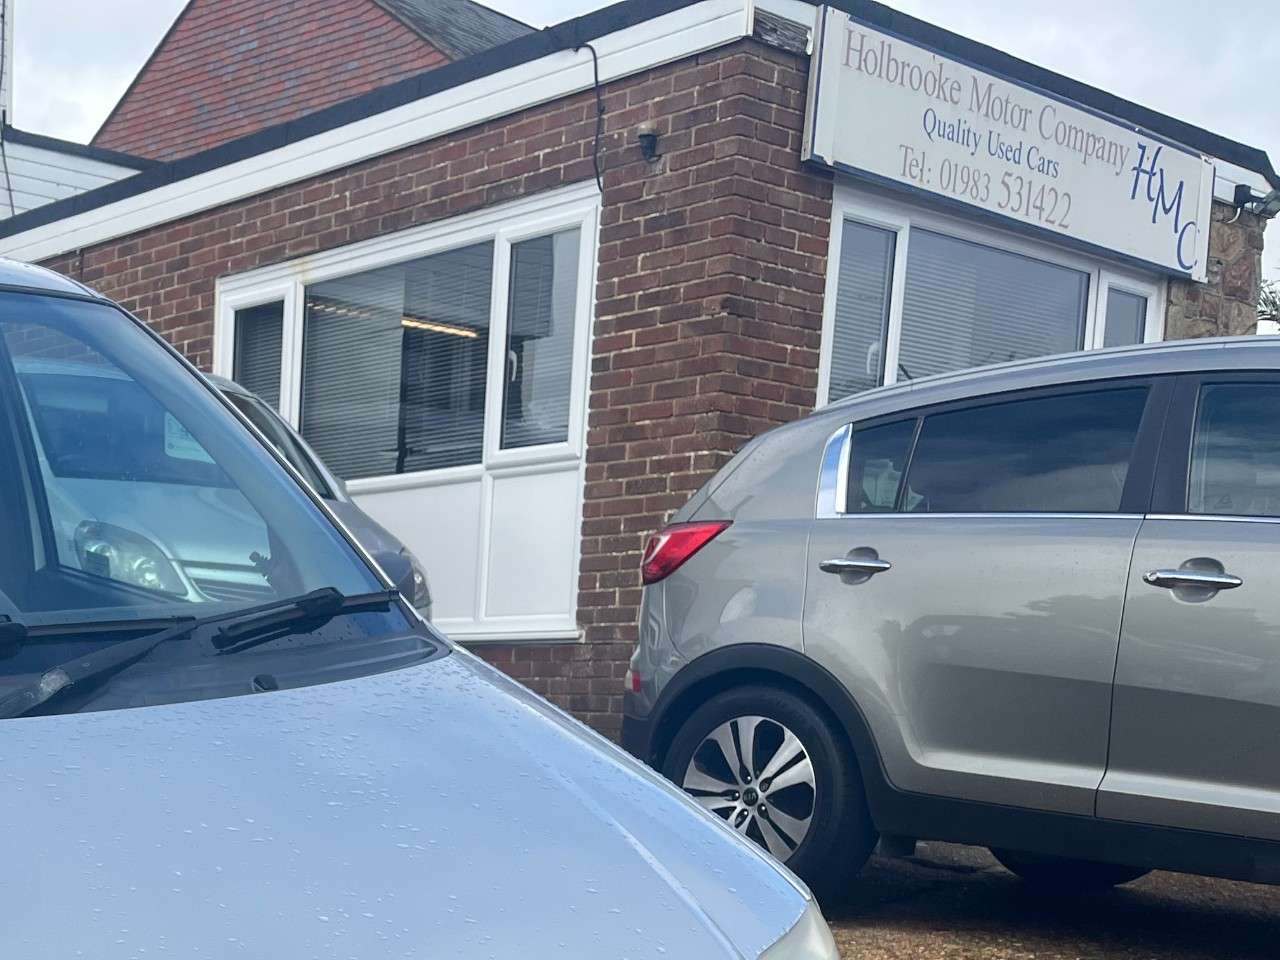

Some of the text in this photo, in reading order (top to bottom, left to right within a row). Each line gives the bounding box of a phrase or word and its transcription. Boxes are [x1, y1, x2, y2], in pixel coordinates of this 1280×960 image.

[842, 28, 1130, 176] Holbrooke Motor Company
[923, 107, 1060, 179] Quality Used Cars
[899, 144, 1072, 229] Tel: 01983 531422
